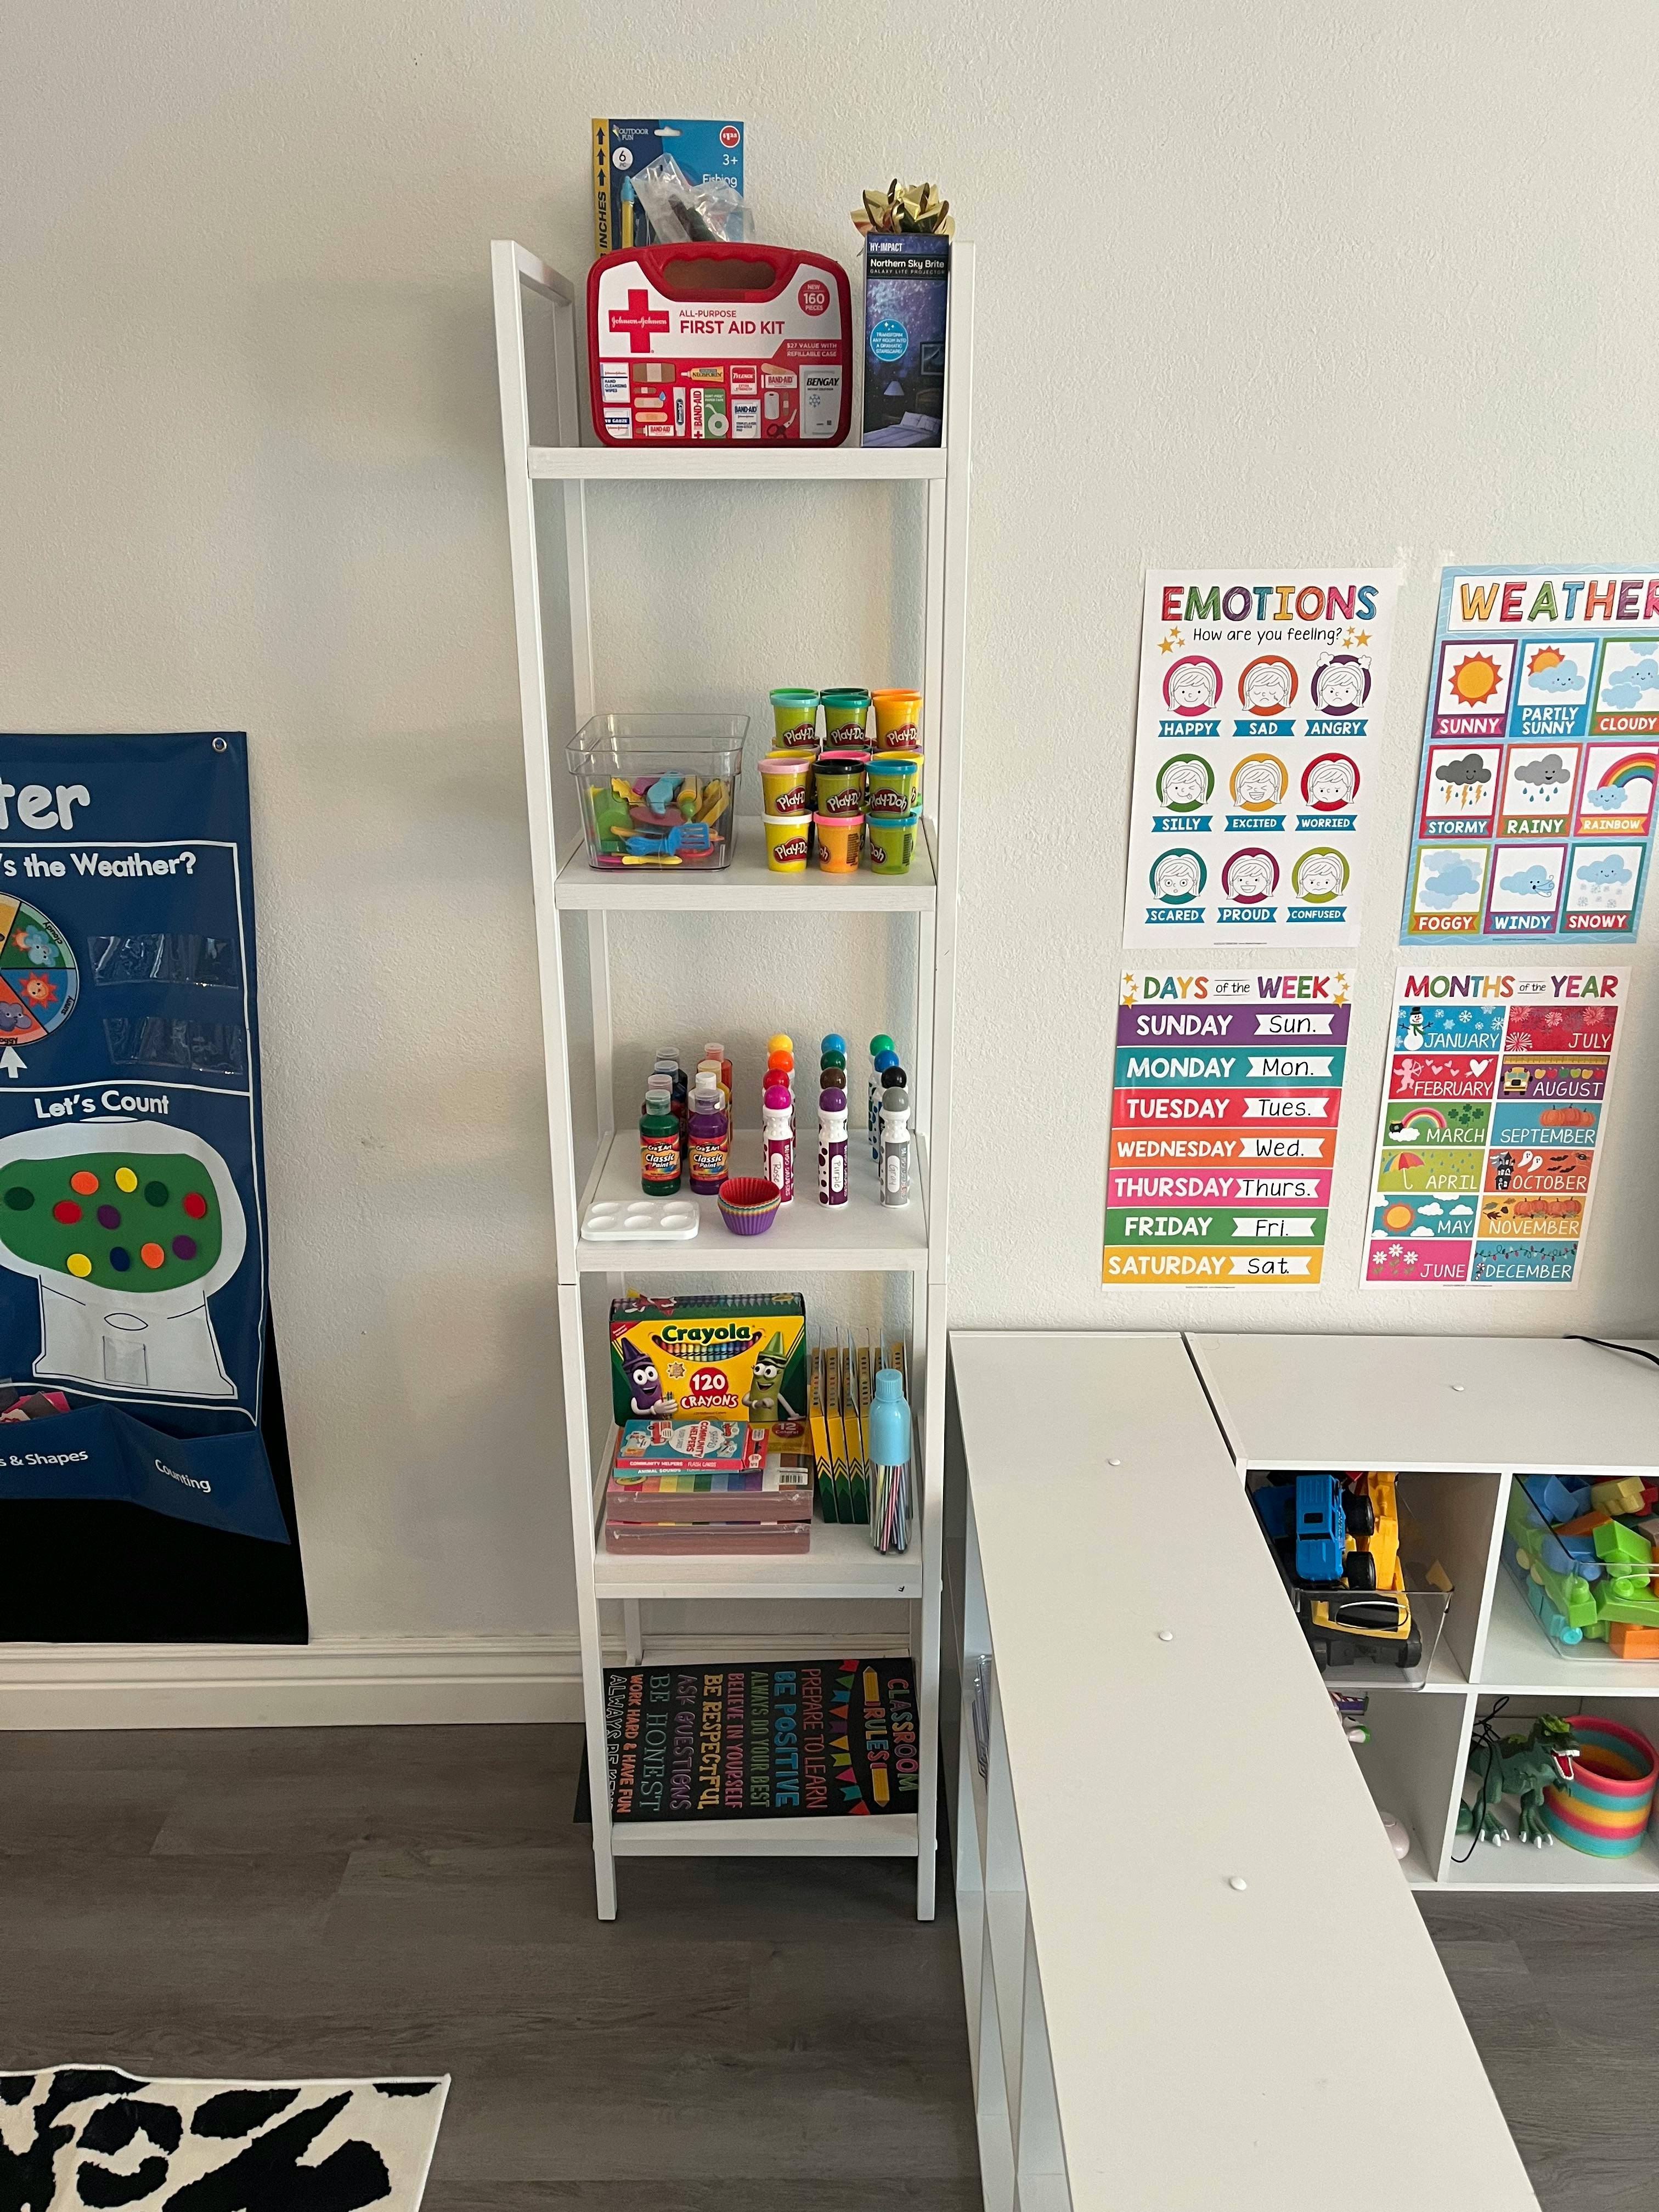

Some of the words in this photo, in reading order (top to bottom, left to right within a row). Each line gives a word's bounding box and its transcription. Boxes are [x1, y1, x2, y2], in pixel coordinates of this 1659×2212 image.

[619, 150, 626, 162] 6
[723, 154, 738, 165] 3+
[598, 191, 607, 249] INCHES
[870, 259, 906, 267] Northern
[908, 260, 923, 269] Sky
[803, 294, 825, 304] 160
[680, 320, 724, 334] FIRST
[728, 321, 756, 334] AID
[760, 321, 785, 334] KIT
[806, 377, 839, 386] BENGAY
[693, 390, 703, 427] BAND-AID
[735, 405, 757, 414] BAND-AID
[1161, 585, 1379, 622] EMOTIONS
[1193, 628, 1222, 641] How
[1227, 630, 1251, 641] are
[1257, 630, 1282, 645] you
[1287, 627, 1342, 645] feeling?
[1522, 707, 1579, 721] PARTLY
[1164, 722, 1214, 736] HAPPY
[1249, 722, 1278, 735] SAD
[1311, 721, 1361, 735] ANGRY
[1440, 718, 1499, 734] SUNNY
[1522, 721, 1575, 735] SUNNY
[1600, 717, 1657, 731] CLOUDY
[1162, 818, 1201, 831] SILLY
[1232, 818, 1277, 828] EXCITED
[1301, 818, 1350, 828] WORRIED
[1428, 821, 1488, 833] STORMY
[1507, 820, 1564, 833] RAINY
[1583, 820, 1640, 830] RAINBOW
[24, 853, 66, 877] the
[70, 851, 196, 877] Weather?
[1150, 910, 1199, 921] SCARED
[1222, 909, 1270, 921] PROUD
[1291, 910, 1341, 919] CONFUSED
[1418, 916, 1474, 930] FOGGY
[1494, 916, 1551, 929] WINDY
[1568, 915, 1627, 929] SNOWY
[42, 921, 63, 945] cloudy
[1144, 976, 1209, 1000] DAYS
[1216, 983, 1229, 994] of
[1231, 983, 1250, 993] the
[1258, 975, 1330, 999] WEEK
[1404, 975, 1516, 998] MONTHS
[1519, 983, 1530, 992] of
[1532, 983, 1546, 992] the
[1551, 975, 1619, 998] YEAR
[60, 995, 75, 1015] sunny
[1136, 1014, 1233, 1036] SUNDAY
[1269, 1015, 1316, 1033] Sun.
[1425, 1032, 1500, 1049] JANUARY
[1568, 1032, 1612, 1049] JULY
[1126, 1057, 1236, 1079] MONDAY
[1262, 1058, 1314, 1076] Mon.
[1414, 1081, 1493, 1097] FEBRUARY
[1533, 1081, 1604, 1097] AUGUST
[35, 1094, 96, 1118] Let's
[101, 1090, 169, 1114] Count
[1126, 1098, 1230, 1119] TUESDAY
[1259, 1099, 1311, 1116] Tues.
[1426, 1128, 1486, 1143] MARCH
[1500, 1128, 1595, 1144] SEPTEMBER
[1117, 1141, 1237, 1158] WEDNESDAY
[1256, 1139, 1304, 1156] Wed.
[646, 1153, 675, 1163] Classic
[693, 1153, 723, 1163] Classic
[773, 1162, 781, 1183] Rose
[833, 1160, 842, 1188] Purple
[1114, 1177, 1234, 1198] THURSDAY
[1243, 1179, 1311, 1197] Thurs.
[1425, 1175, 1479, 1190] APRIL
[1513, 1175, 1588, 1190] OCTOBER
[1125, 1216, 1214, 1237] FRIDAY
[1256, 1219, 1288, 1237] Fri.
[1437, 1220, 1472, 1234] MAY
[1489, 1220, 1579, 1235] NOVEMBER
[1108, 1256, 1227, 1276] SATURDAY
[1248, 1258, 1289, 1274] Sat.
[1420, 1263, 1466, 1278] JUNE
[1486, 1264, 1572, 1279] DECEMBER
[662, 1323, 751, 1344] Crayola
[692, 1374, 726, 1391] 120
[681, 1394, 737, 1408] CRAYONS
[686, 1426, 695, 1452] HELPERS
[696, 1421, 708, 1458] COMMUNITY
[10, 1455, 23, 1466] &
[25, 1450, 88, 1468] Shapes
[154, 1459, 212, 1493] Counting
[628, 1674, 643, 1706] WORK
[650, 1674, 670, 1702] BE
[676, 1674, 697, 1705] ASK
[703, 1674, 723, 1696] BE
[774, 1671, 796, 1696] BE
[726, 1673, 744, 1720] BELIEVE
[751, 1671, 769, 1716] ALWAYS
[801, 1669, 823, 1730] PREPARE
[606, 1674, 627, 1739] ALWAYS
[625, 1709, 640, 1739] HARD
[726, 1725, 743, 1739] IN
[751, 1720, 769, 1735] DO
[804, 1734, 825, 1752] TO
[864, 1707, 890, 1761] RULES
[887, 1678, 918, 1792] CLASSROOM
[640, 1713, 668, 1811] HONEST
[669, 1712, 696, 1810] QUESTIONS
[697, 1701, 722, 1809] RESPECTFUL
[751, 1739, 769, 1771] YOUR
[774, 1703, 799, 1807] POSITIVE
[620, 1754, 636, 1785] HAVE
[725, 1743, 743, 1809] YOURSELF
[751, 1776, 770, 1807] BEST
[804, 1757, 828, 1809] LEARN
[617, 1789, 633, 1813] FUN
